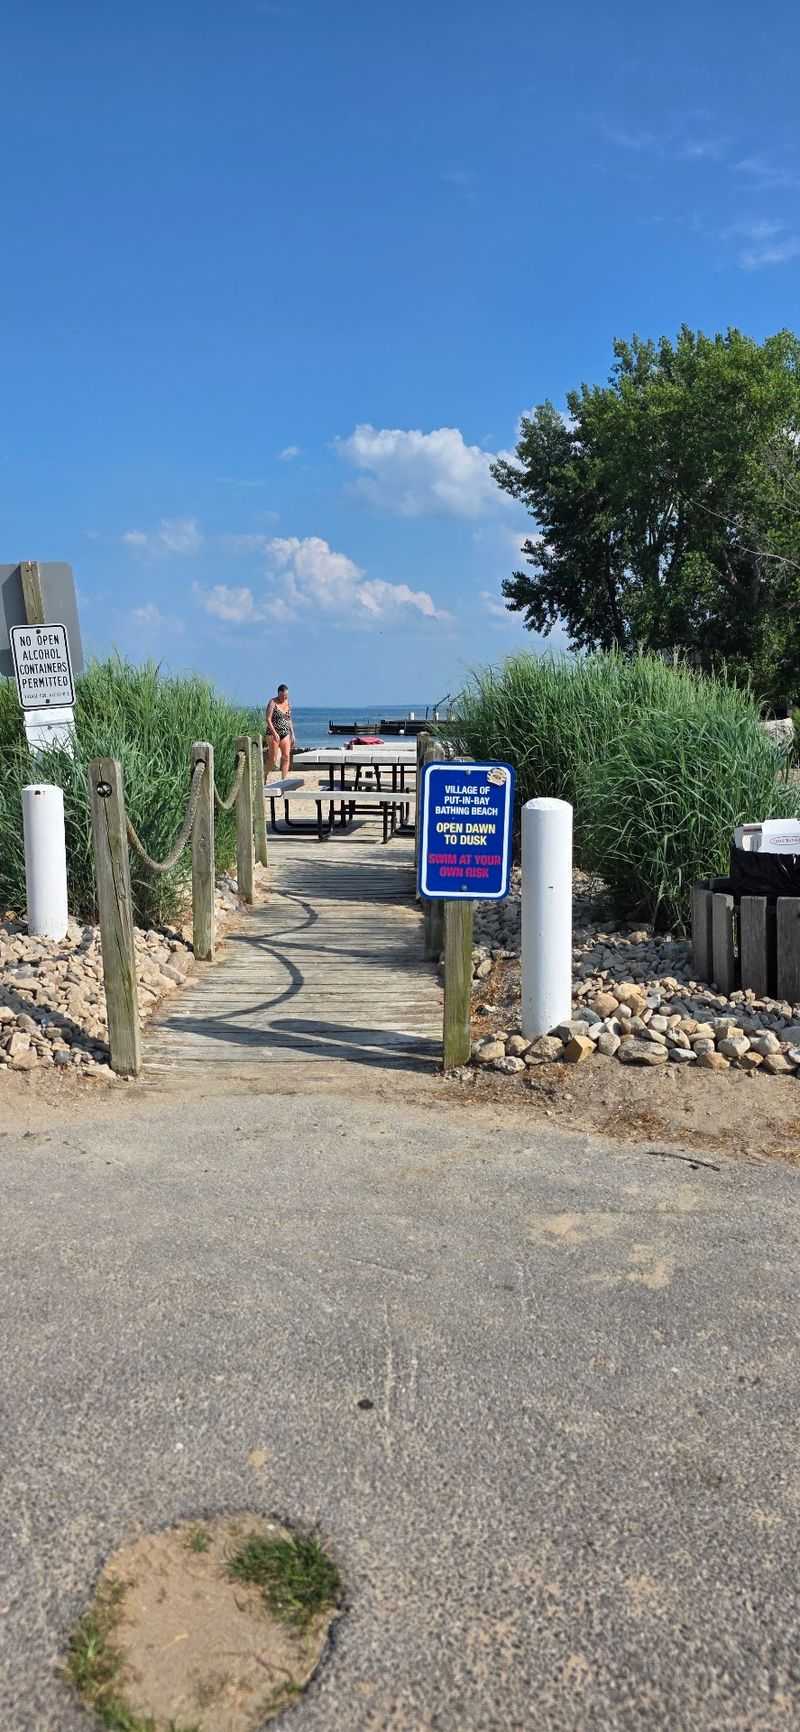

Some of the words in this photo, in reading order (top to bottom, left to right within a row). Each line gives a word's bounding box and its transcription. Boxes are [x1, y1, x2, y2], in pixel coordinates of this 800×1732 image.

[20, 636, 31, 646] NO
[38, 635, 59, 645] OPEN
[23, 648, 61, 660] ALCOHOL
[20, 662, 67, 675] CONTAINERS
[22, 676, 68, 688] PERMITTED
[445, 786, 477, 794] VILLAGE
[480, 786, 490, 794] OF
[444, 796, 490, 805] PUT-IN-BAY
[435, 806, 469, 815] BATHING
[472, 807, 498, 816] BEACH
[436, 823, 462, 833] OPEN
[466, 824, 496, 834] DAWN
[444, 834, 456, 844] TO
[460, 835, 486, 845] DUSK
[428, 854, 456, 864] SWIM
[459, 854, 472, 864] AT
[475, 855, 500, 865] YOUR
[440, 867, 464, 877] OWN
[466, 868, 488, 878] RISK
